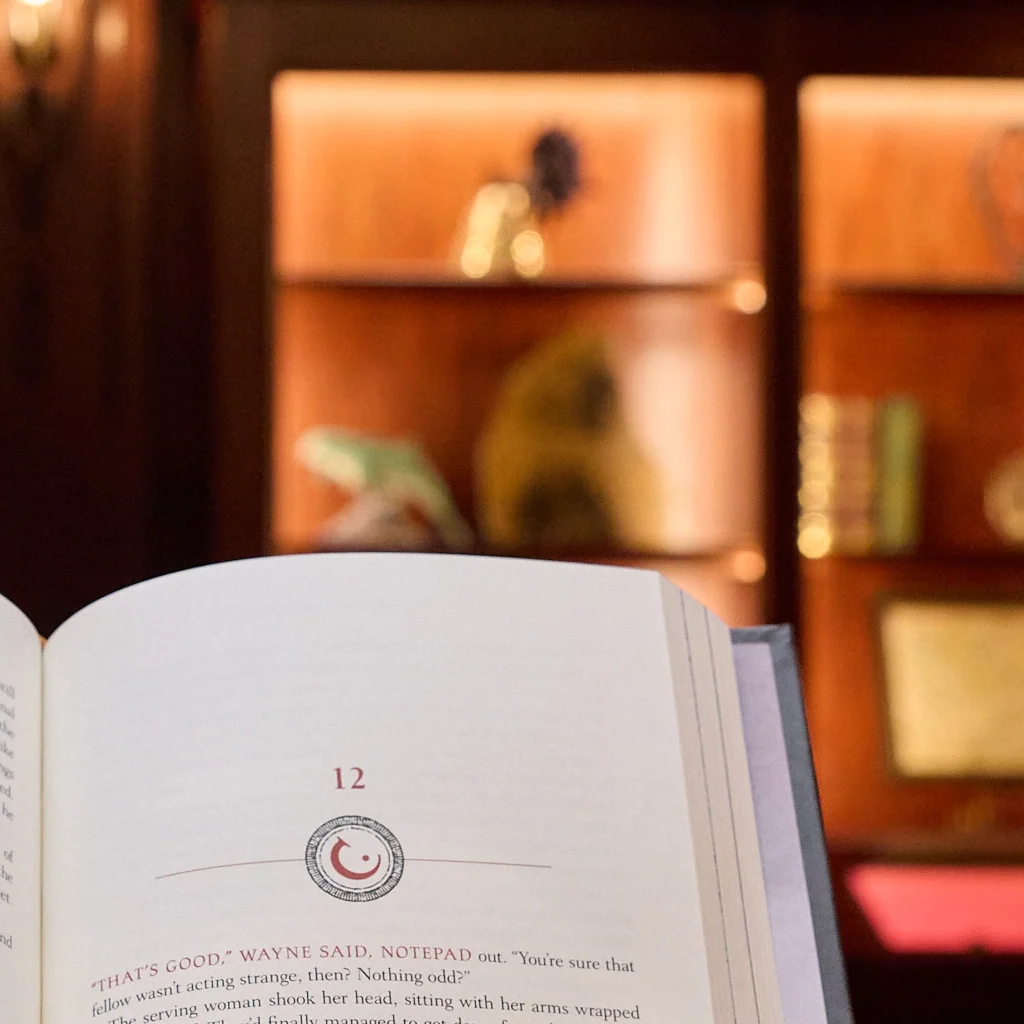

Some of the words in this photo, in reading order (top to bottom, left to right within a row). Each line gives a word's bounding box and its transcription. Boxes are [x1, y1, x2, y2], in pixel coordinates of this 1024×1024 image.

[332, 766, 367, 790] 12
[90, 962, 158, 992] “THAT’S
[165, 949, 232, 973] GOOD,”
[238, 945, 311, 962] WAYNE
[318, 944, 372, 959] SAID,
[380, 945, 472, 961] NOTEPAD
[477, 951, 507, 964] out.
[510, 950, 563, 968] “You’re
[567, 958, 600, 970] sure
[604, 956, 634, 972] that
[91, 995, 131, 1017] fellow
[135, 979, 181, 1002] wasn’t
[185, 975, 235, 992] acting
[238, 972, 302, 987] strange,
[307, 966, 351, 981] then?
[356, 966, 424, 987] Nothing
[426, 968, 470, 984] odd?”
